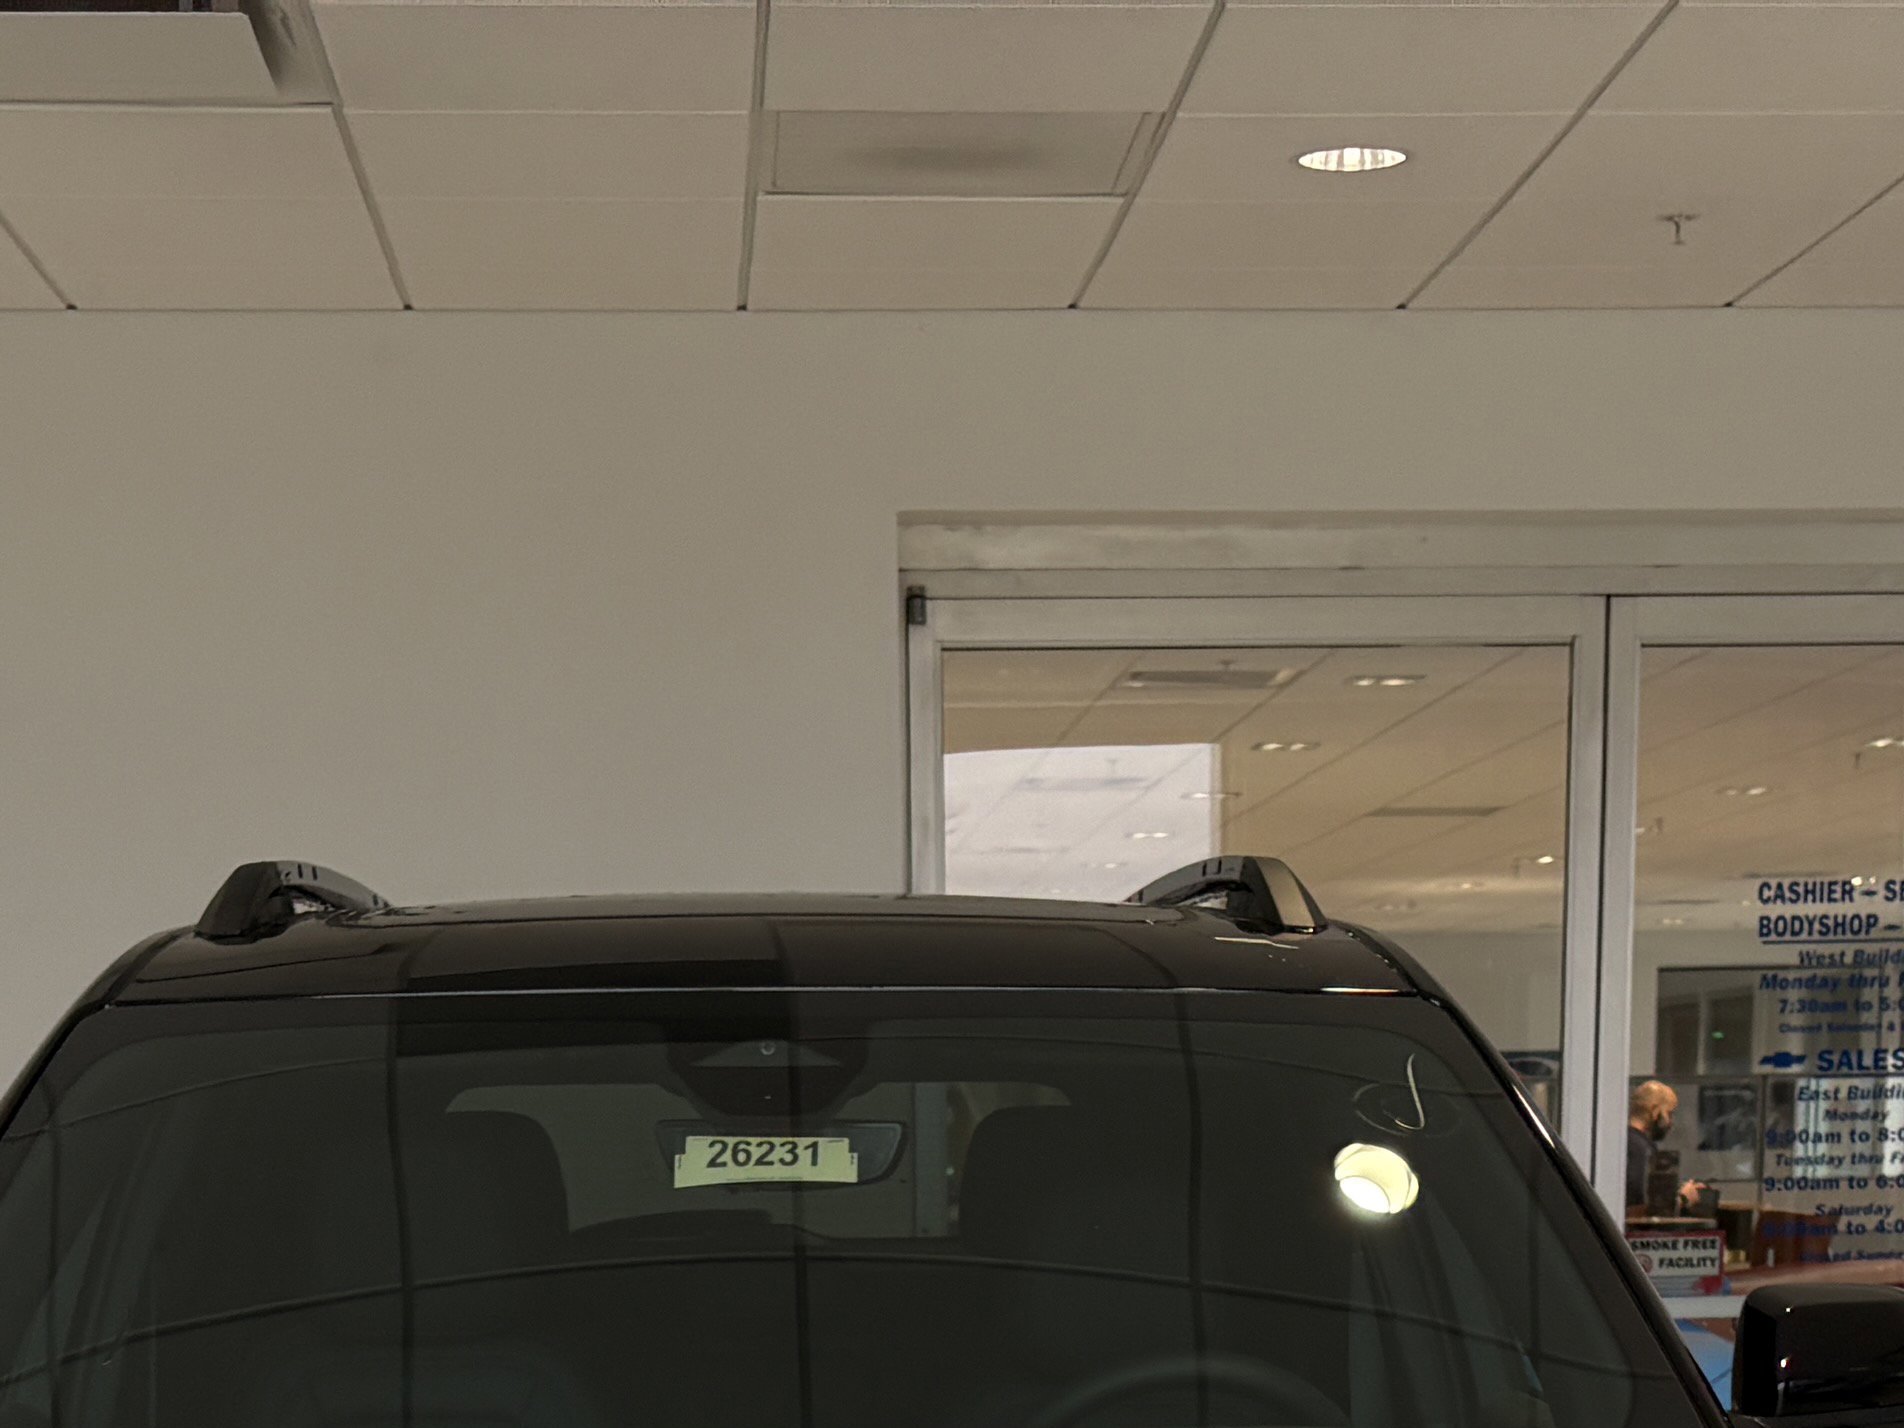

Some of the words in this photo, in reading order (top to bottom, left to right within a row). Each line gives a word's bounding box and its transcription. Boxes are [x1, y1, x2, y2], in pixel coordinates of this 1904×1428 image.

[1758, 880, 1855, 904] CASHIER
[1758, 914, 1879, 938] BODYSHOP
[1799, 950, 1846, 967] West
[1759, 974, 1841, 992] Monday
[1848, 973, 1889, 990] thru
[1854, 999, 1873, 1013] to
[1798, 1085, 1841, 1101] East
[1823, 1109, 1889, 1122] Monday
[1849, 1129, 1871, 1144] to
[706, 1140, 820, 1168] 26231
[1775, 1153, 1846, 1168] Tuesday
[1850, 1152, 1883, 1165] thru
[1764, 1176, 1840, 1192] 9:00am
[1848, 1175, 1869, 1189] to
[1815, 1203, 1895, 1218] Saturday
[1847, 1220, 1866, 1236] to
[1631, 1240, 1678, 1251] SMOKE
[1682, 1239, 1717, 1250] FREE
[1658, 1257, 1717, 1268] FACILITY
